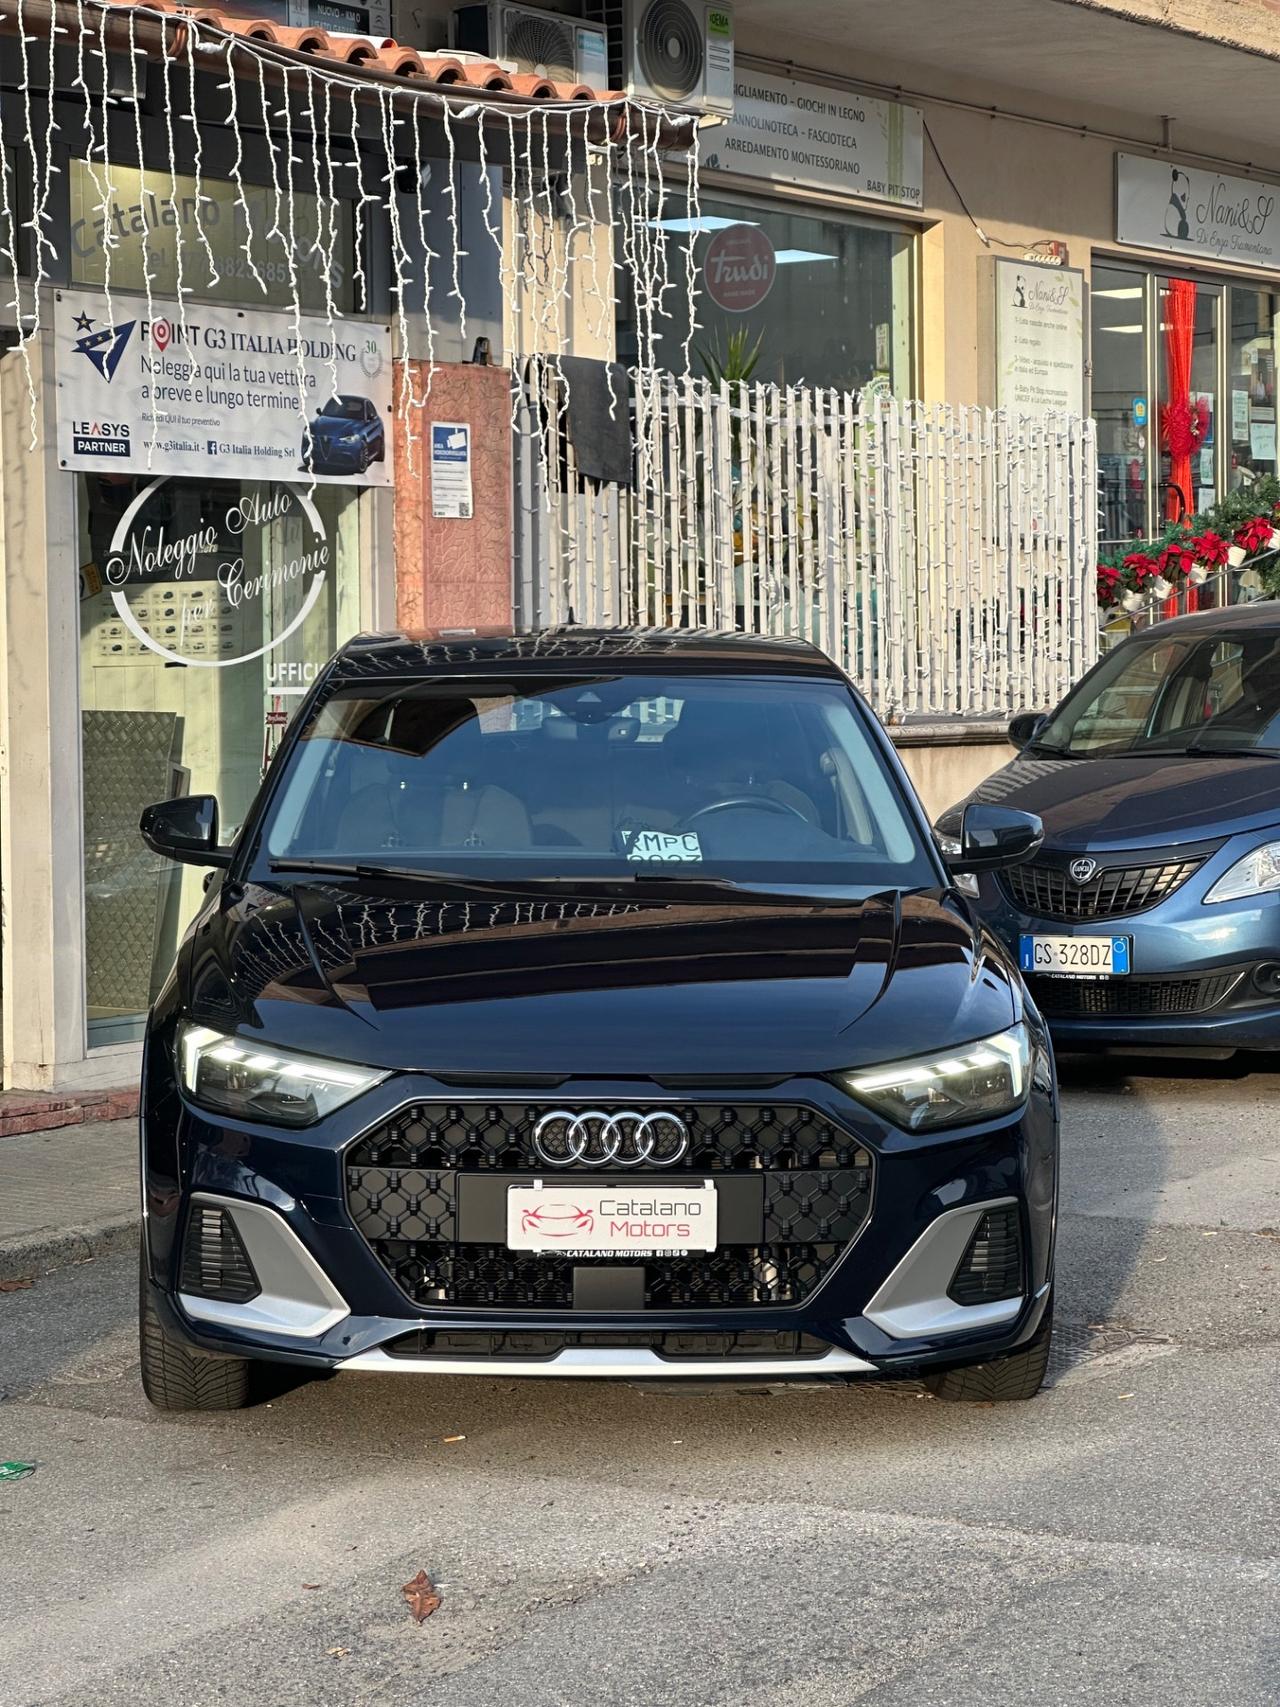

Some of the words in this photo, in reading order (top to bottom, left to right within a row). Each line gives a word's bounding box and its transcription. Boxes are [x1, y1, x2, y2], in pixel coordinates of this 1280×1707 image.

[317, 4, 340, 18] NUOVO
[797, 99, 826, 114] GIOCHI
[828, 105, 837, 117] IN
[838, 107, 865, 123] LEGNO
[808, 128, 857, 149] FASCIOTECA
[725, 137, 789, 161] ARREDAMENTO
[791, 152, 860, 175] MONTESSORIANO
[867, 179, 886, 193] BABY
[888, 184, 899, 196] PIT
[900, 185, 920, 199] STOP
[71, 194, 220, 259] Catalano
[204, 327, 227, 349] G3
[231, 332, 284, 355] ITALIA
[365, 340, 377, 354] 30
[205, 362, 225, 383] qui
[229, 362, 240, 383] la
[244, 366, 265, 384] tua
[141, 384, 149, 399] a
[195, 389, 203, 404] e
[207, 385, 244, 409] lungo
[247, 389, 299, 411] termine
[165, 414, 176, 424] QUI
[191, 417, 220, 427] preventivo
[77, 442, 126, 453] PARTNER
[219, 443, 230, 454] G3
[232, 444, 252, 455] Italia
[254, 445, 282, 458] Holding
[284, 447, 295, 457] Srl
[226, 491, 293, 534] Auto
[106, 517, 218, 585] Noleggio
[217, 537, 330, 609] Cerimonie
[266, 662, 325, 681] UFFICI
[1059, 944, 1112, 966] 328DZ
[600, 1200, 701, 1216] Catalano
[610, 1220, 690, 1237] Motors
[566, 1250, 613, 1258] CATALANO
[615, 1250, 653, 1258] MOTORS
